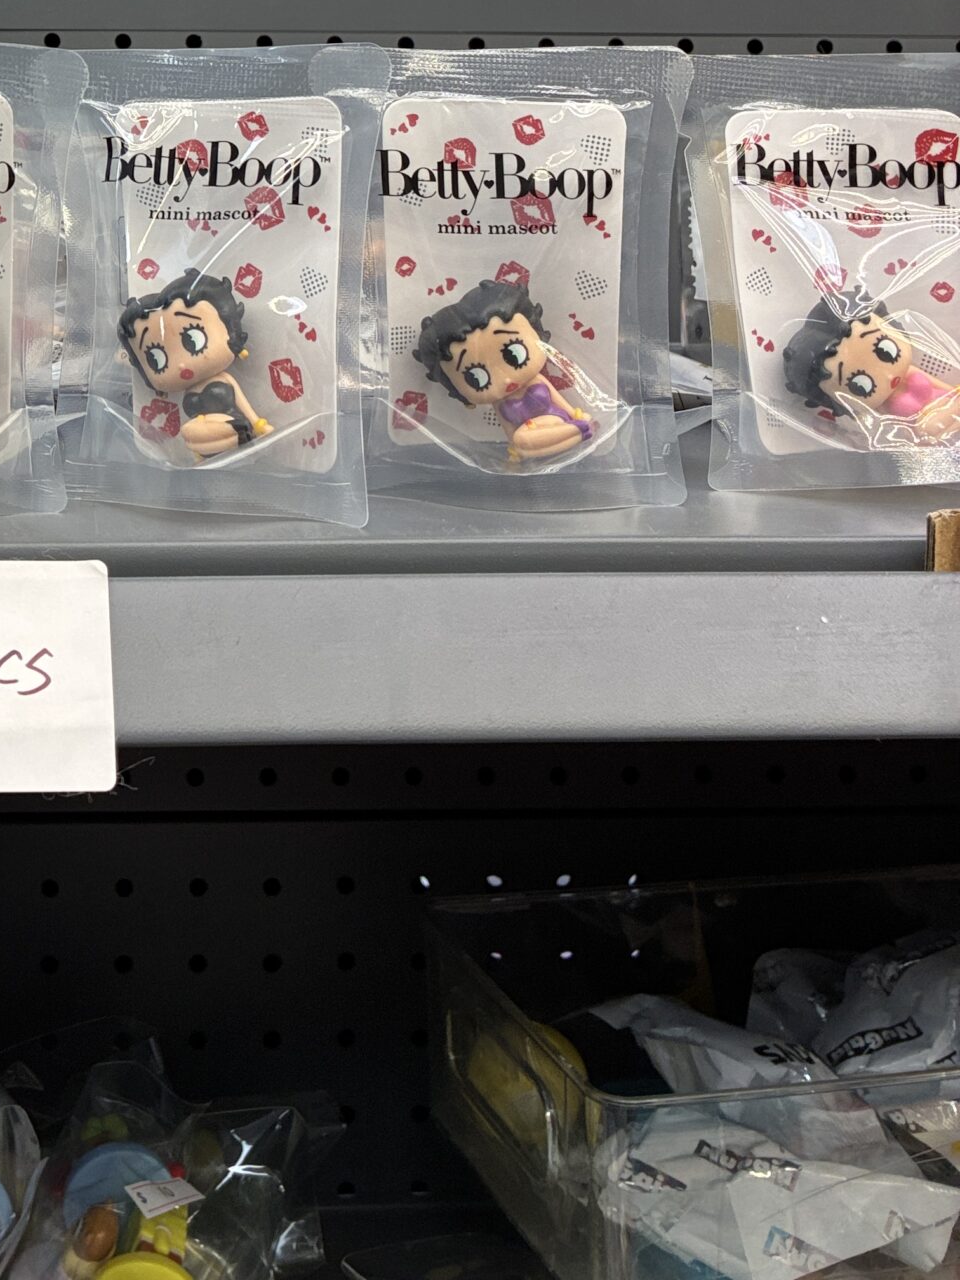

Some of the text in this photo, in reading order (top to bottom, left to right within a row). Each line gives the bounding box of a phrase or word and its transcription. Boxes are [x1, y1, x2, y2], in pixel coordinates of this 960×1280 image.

[102, 135, 200, 202] Betty
[206, 140, 322, 206] Boop
[375, 148, 487, 217] Betty
[490, 151, 613, 218] Boop
[732, 142, 837, 205] Betty
[148, 206, 260, 222] mini mascot
[437, 221, 558, 236] mini mascot
